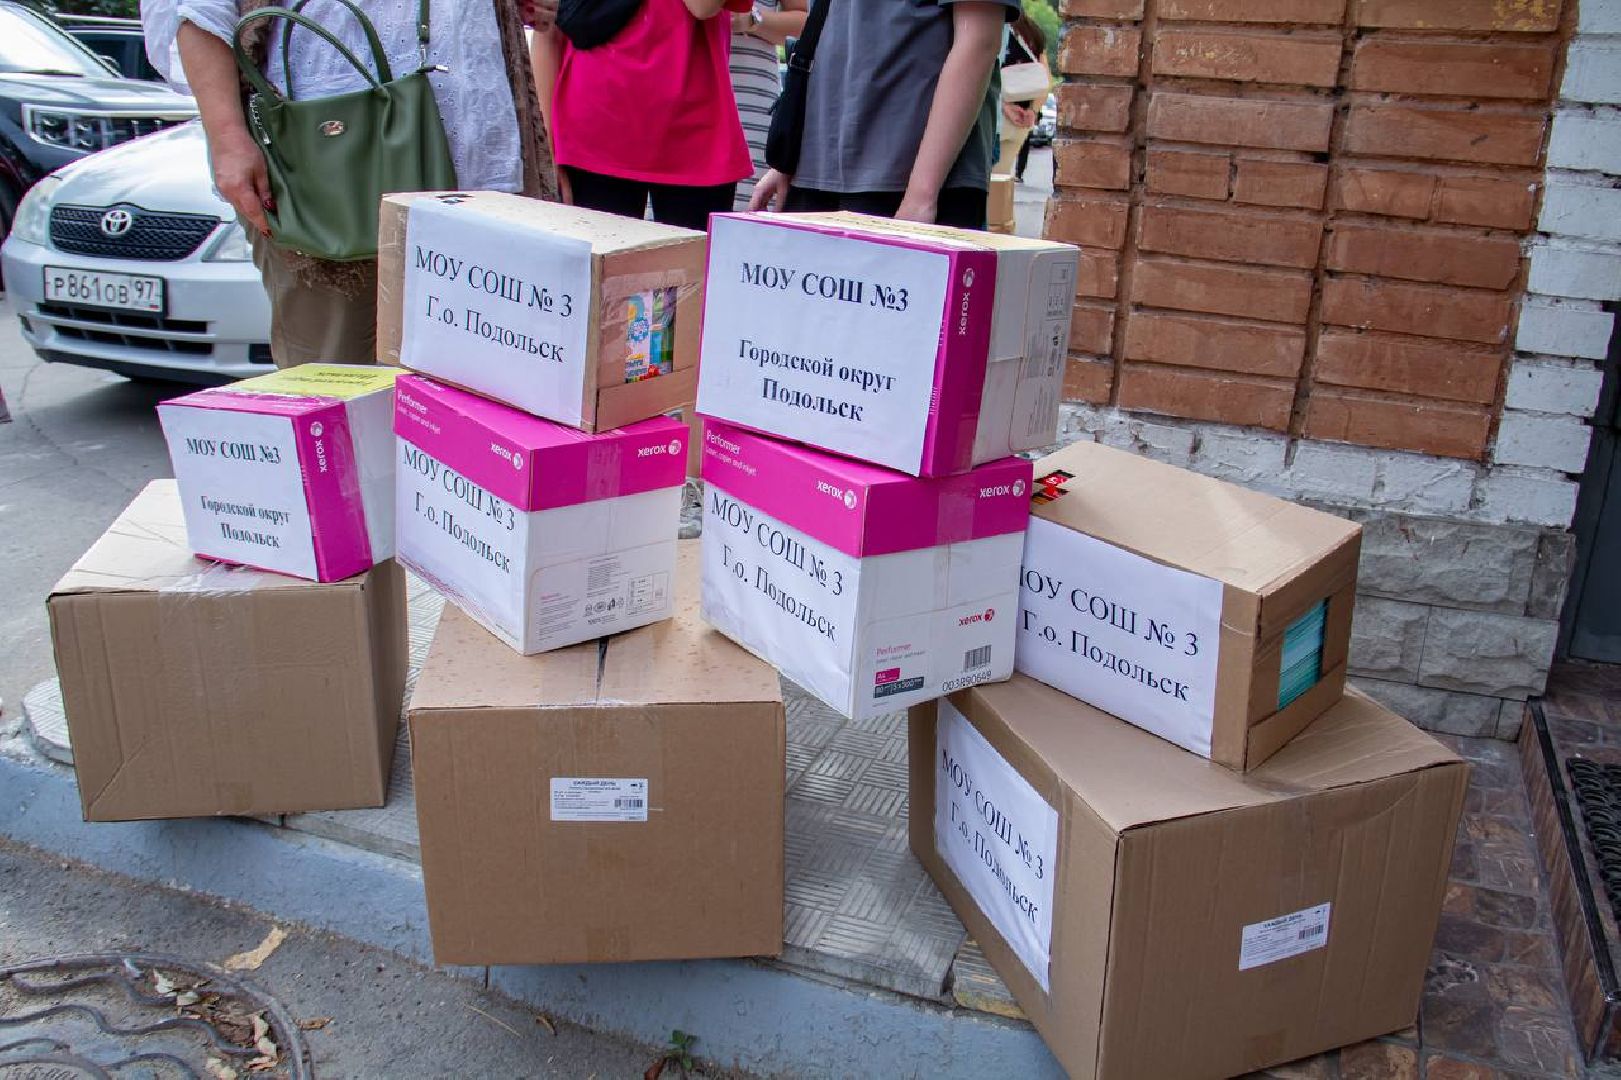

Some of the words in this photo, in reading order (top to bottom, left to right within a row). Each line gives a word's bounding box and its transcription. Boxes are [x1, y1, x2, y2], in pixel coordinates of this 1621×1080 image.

[415, 245, 463, 281] МОУ
[468, 264, 523, 303] СОШ
[528, 284, 553, 312] №
[560, 294, 572, 317] 3
[741, 262, 796, 290] МОУ
[801, 272, 863, 303] СОШ
[425, 295, 459, 327] Г.о.
[464, 307, 564, 363] Подольск
[958, 292, 970, 336] xerox
[739, 339, 834, 378] Городской
[838, 365, 897, 394] округ
[762, 377, 864, 422] Подольск
[186, 438, 217, 456] МОУ
[220, 440, 257, 461] СОШ
[315, 439, 327, 473] xerox
[490, 442, 513, 462] xerox
[637, 444, 667, 459] xerox
[706, 429, 741, 456] Performer
[404, 444, 439, 481] МОУ
[443, 469, 482, 511] СОШ
[486, 496, 503, 525] №
[506, 507, 515, 531] 3
[816, 480, 844, 501] xerox
[979, 485, 1010, 499] xerox
[200, 495, 256, 518] Городской
[258, 509, 291, 525] округ
[415, 491, 439, 525] Г.о.
[443, 510, 510, 573] Подольск
[220, 522, 280, 549] Подольск
[711, 492, 753, 534] МОУ
[757, 523, 805, 570] СОШ
[809, 553, 827, 587] №
[832, 571, 842, 596] 3
[723, 543, 748, 583] Г.о.
[755, 565, 836, 643] Подольск
[1019, 566, 1063, 599] ОУ
[1070, 588, 1138, 635] СОШ
[1143, 618, 1175, 650] №
[1184, 632, 1199, 656] 3
[958, 613, 982, 627] xerox
[1022, 609, 1062, 646] Г.о.
[1071, 630, 1190, 702] Подольск
[942, 749, 973, 797] МОУ
[975, 790, 1012, 845] СОШ
[1035, 855, 1044, 880] 3
[974, 830, 1038, 923] Подольск
